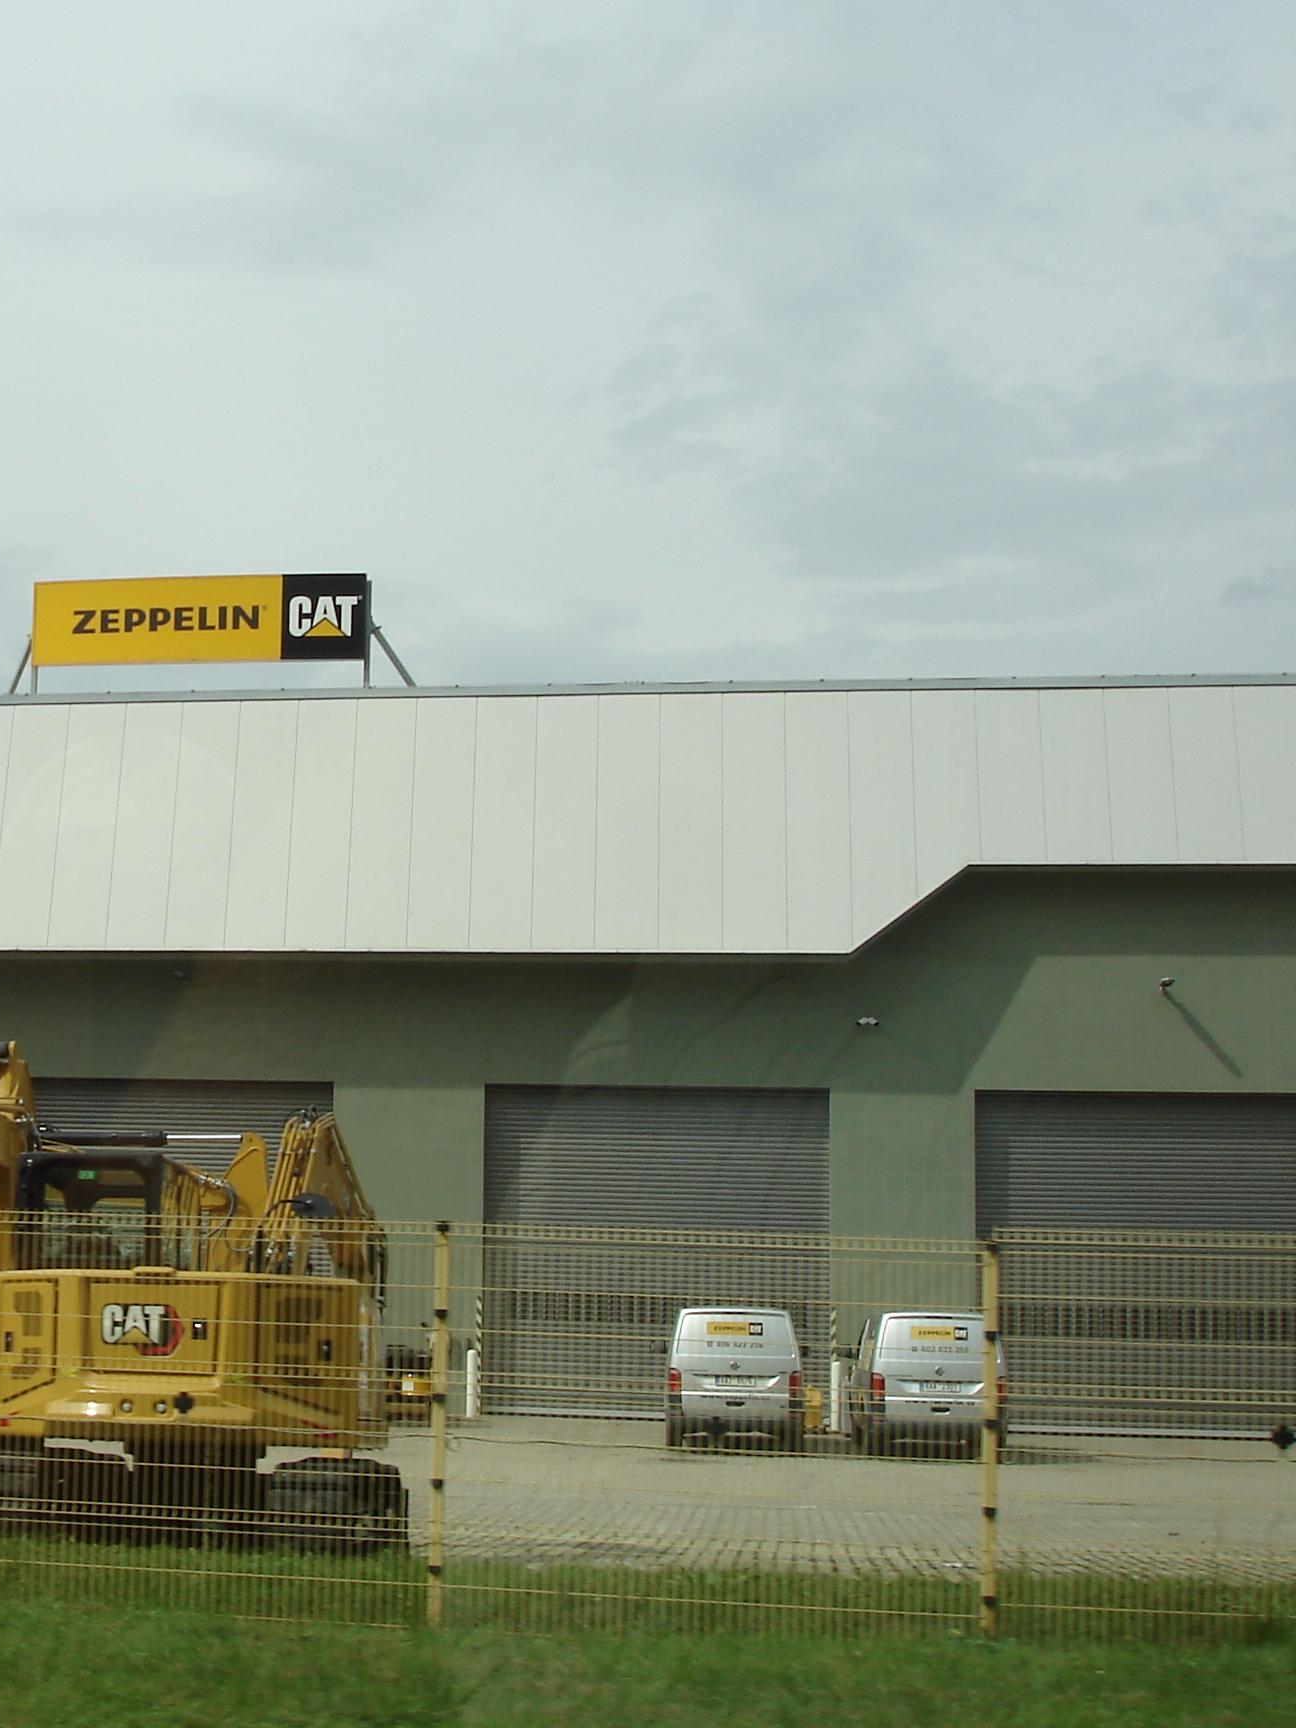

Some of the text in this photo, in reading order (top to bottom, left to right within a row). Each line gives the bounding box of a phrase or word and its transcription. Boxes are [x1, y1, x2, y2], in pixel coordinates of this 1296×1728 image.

[71, 594, 359, 638] ZEPPELIN CAT
[102, 1304, 166, 1344] CAT
